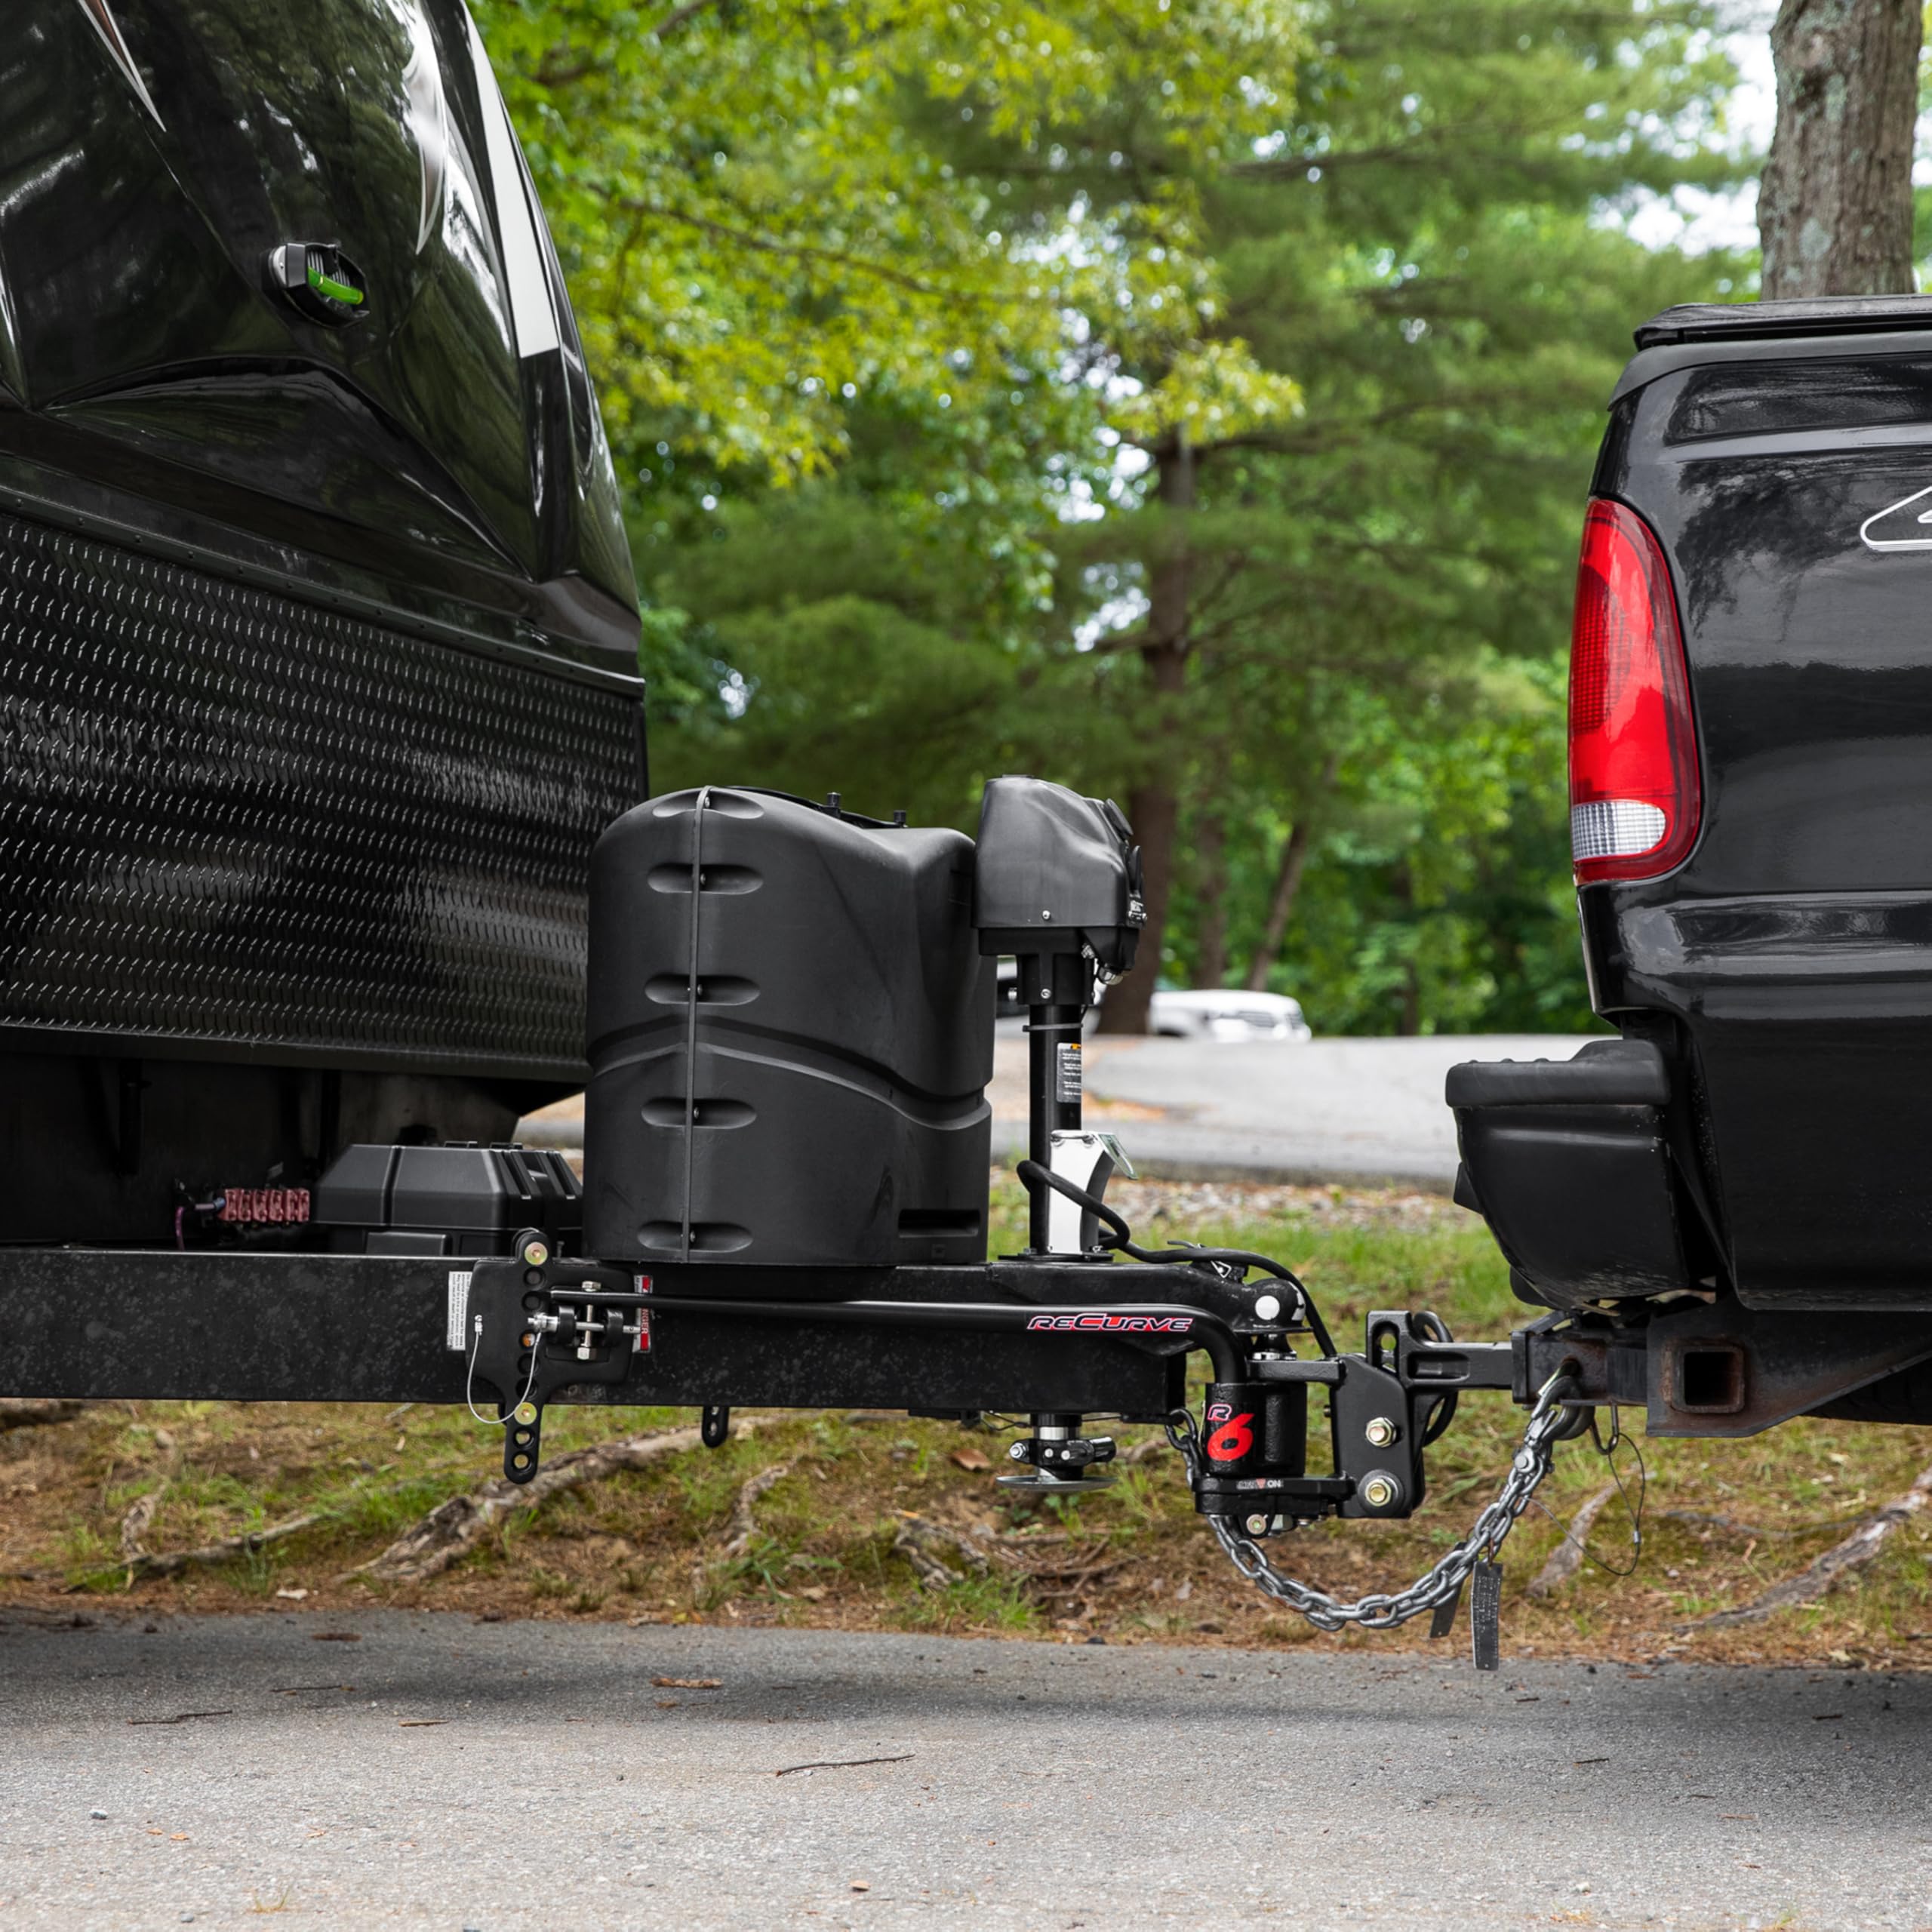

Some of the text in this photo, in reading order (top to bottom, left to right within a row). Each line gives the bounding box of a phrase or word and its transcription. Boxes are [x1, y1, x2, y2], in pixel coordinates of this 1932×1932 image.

[1208, 1403, 1232, 1422] R
[1207, 1413, 1254, 1461] 6
[1266, 1479, 1281, 1488] ON
